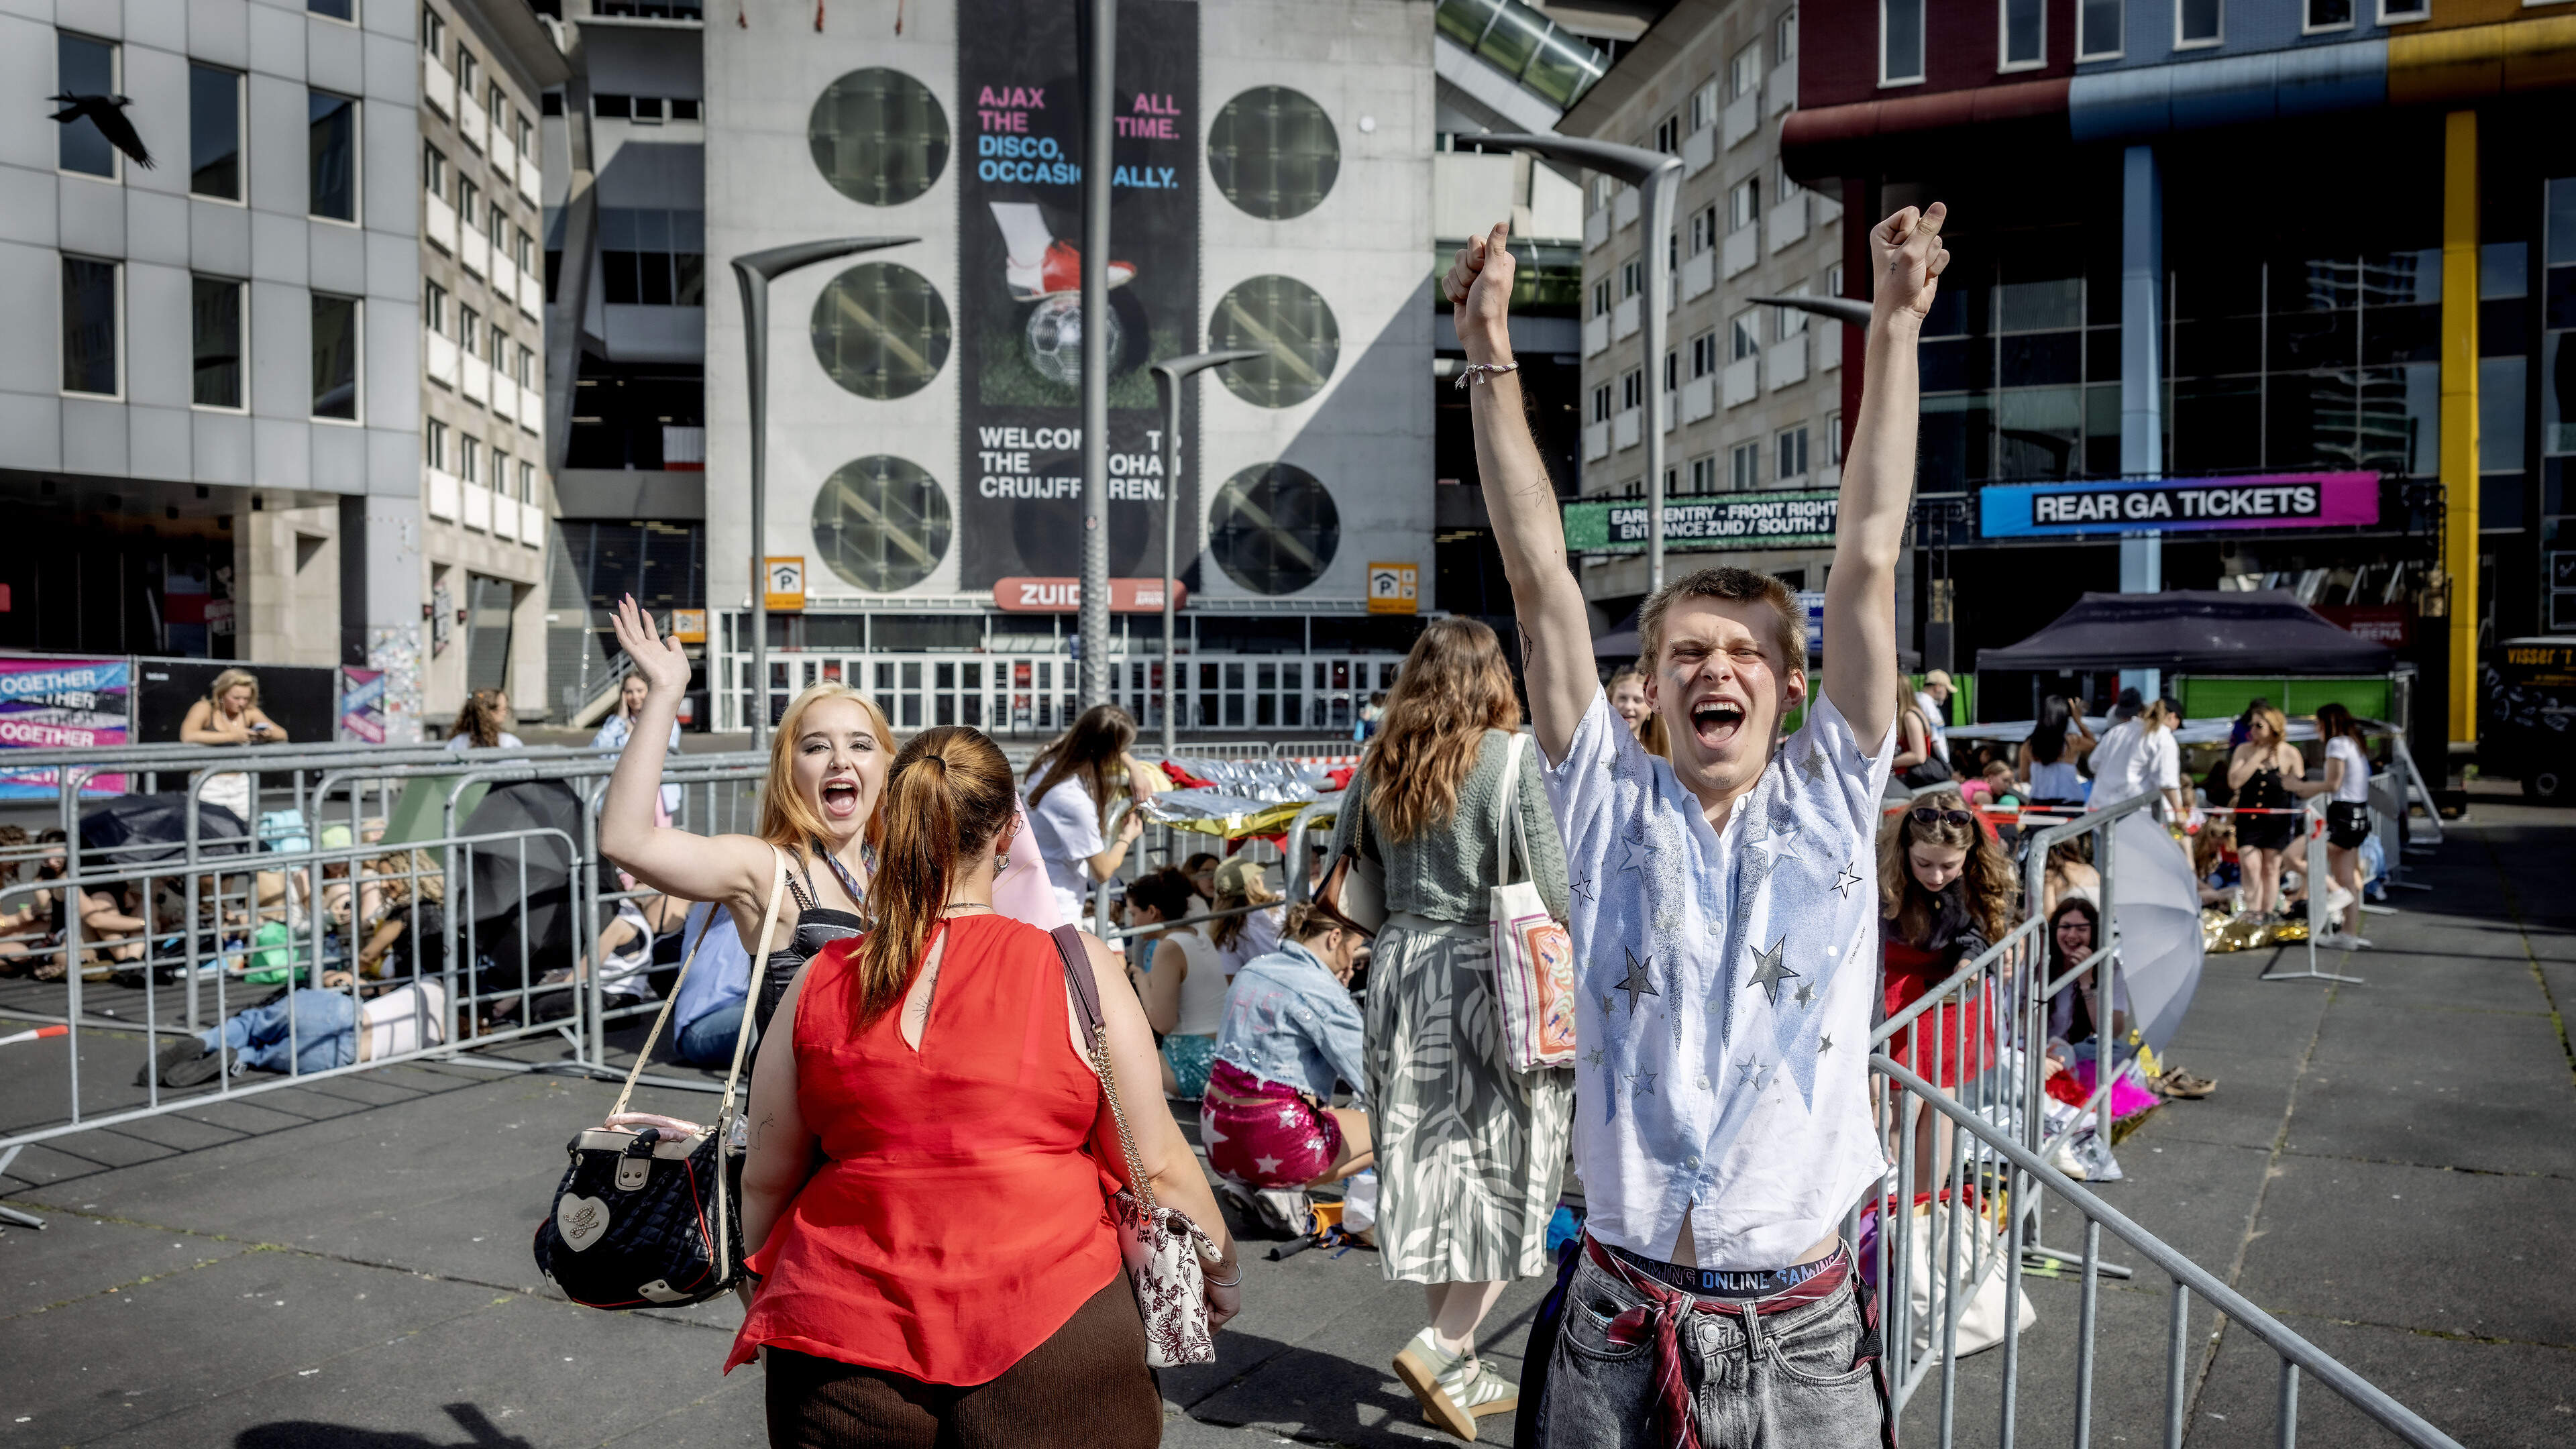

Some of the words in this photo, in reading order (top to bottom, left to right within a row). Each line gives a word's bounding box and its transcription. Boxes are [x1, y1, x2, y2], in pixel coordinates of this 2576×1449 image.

[978, 85, 1045, 109] AJAX
[1133, 93, 1181, 115] ALL
[977, 111, 1029, 133] THE
[1115, 116, 1180, 140] TIME.
[978, 135, 1065, 162] DISCO,
[978, 160, 1179, 189] OCCASIALLY.
[978, 426, 1110, 451] WELCO
[978, 451, 1031, 474] THE
[1108, 453, 1182, 477] OHA
[1611, 508, 1649, 525] EARL
[1663, 504, 1717, 523] ENTRY
[1727, 502, 1785, 520] FRONT
[1786, 499, 1838, 517] RIGHT
[2035, 494, 2118, 523] REAR
[2123, 492, 2173, 520] GA
[2178, 486, 2316, 517] TICKETS
[1620, 521, 1705, 539] ENTANCE
[1705, 519, 1746, 536] ZUID
[1757, 516, 1816, 535] SOUTH
[1817, 515, 1830, 532] J
[0, 669, 95, 695] OGETHER
[0, 721, 95, 747] OGETHER
[1703, 1271, 1770, 1291] ONLINE
